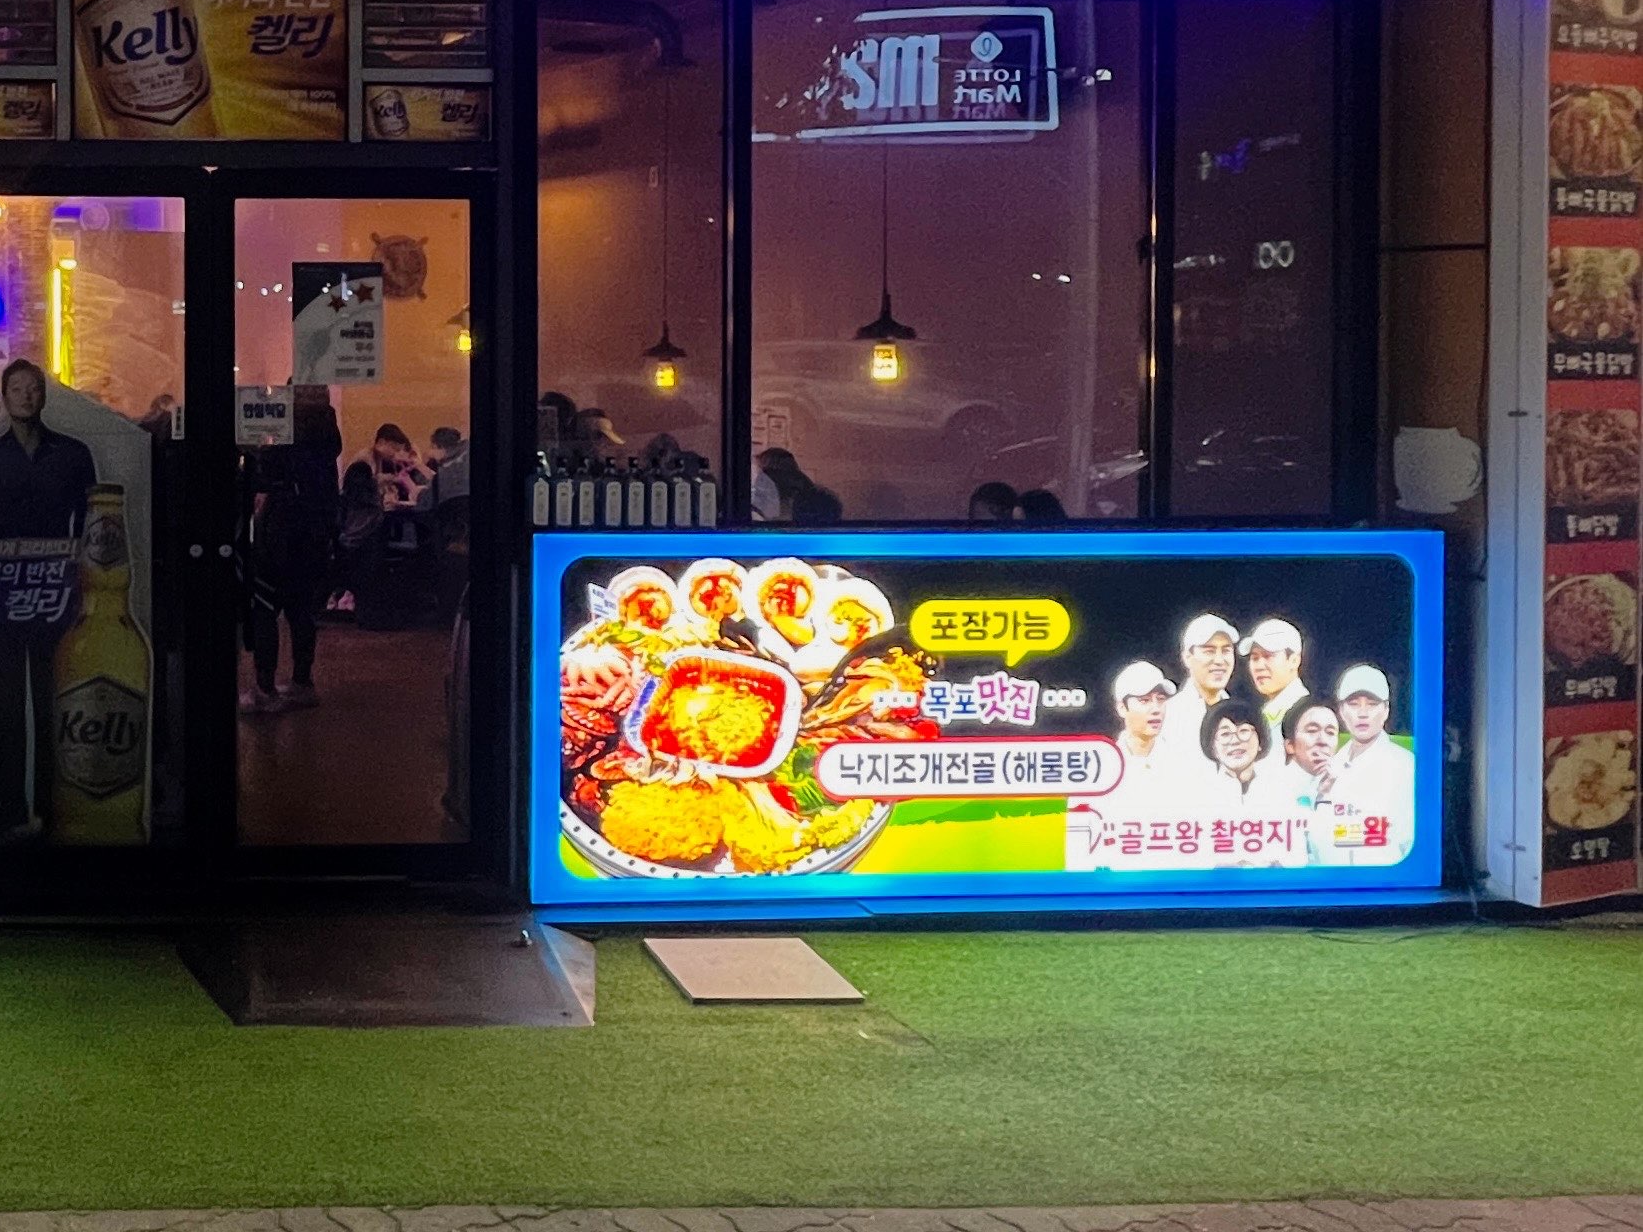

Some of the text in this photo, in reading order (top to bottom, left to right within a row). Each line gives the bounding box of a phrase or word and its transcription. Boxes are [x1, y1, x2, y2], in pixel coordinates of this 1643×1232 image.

[92, 6, 200, 66] Kelly
[248, 12, 335, 59] 켈리
[26, 560, 67, 586] 반전
[7, 587, 72, 623] 켈리
[930, 610, 1050, 641] 포장가능
